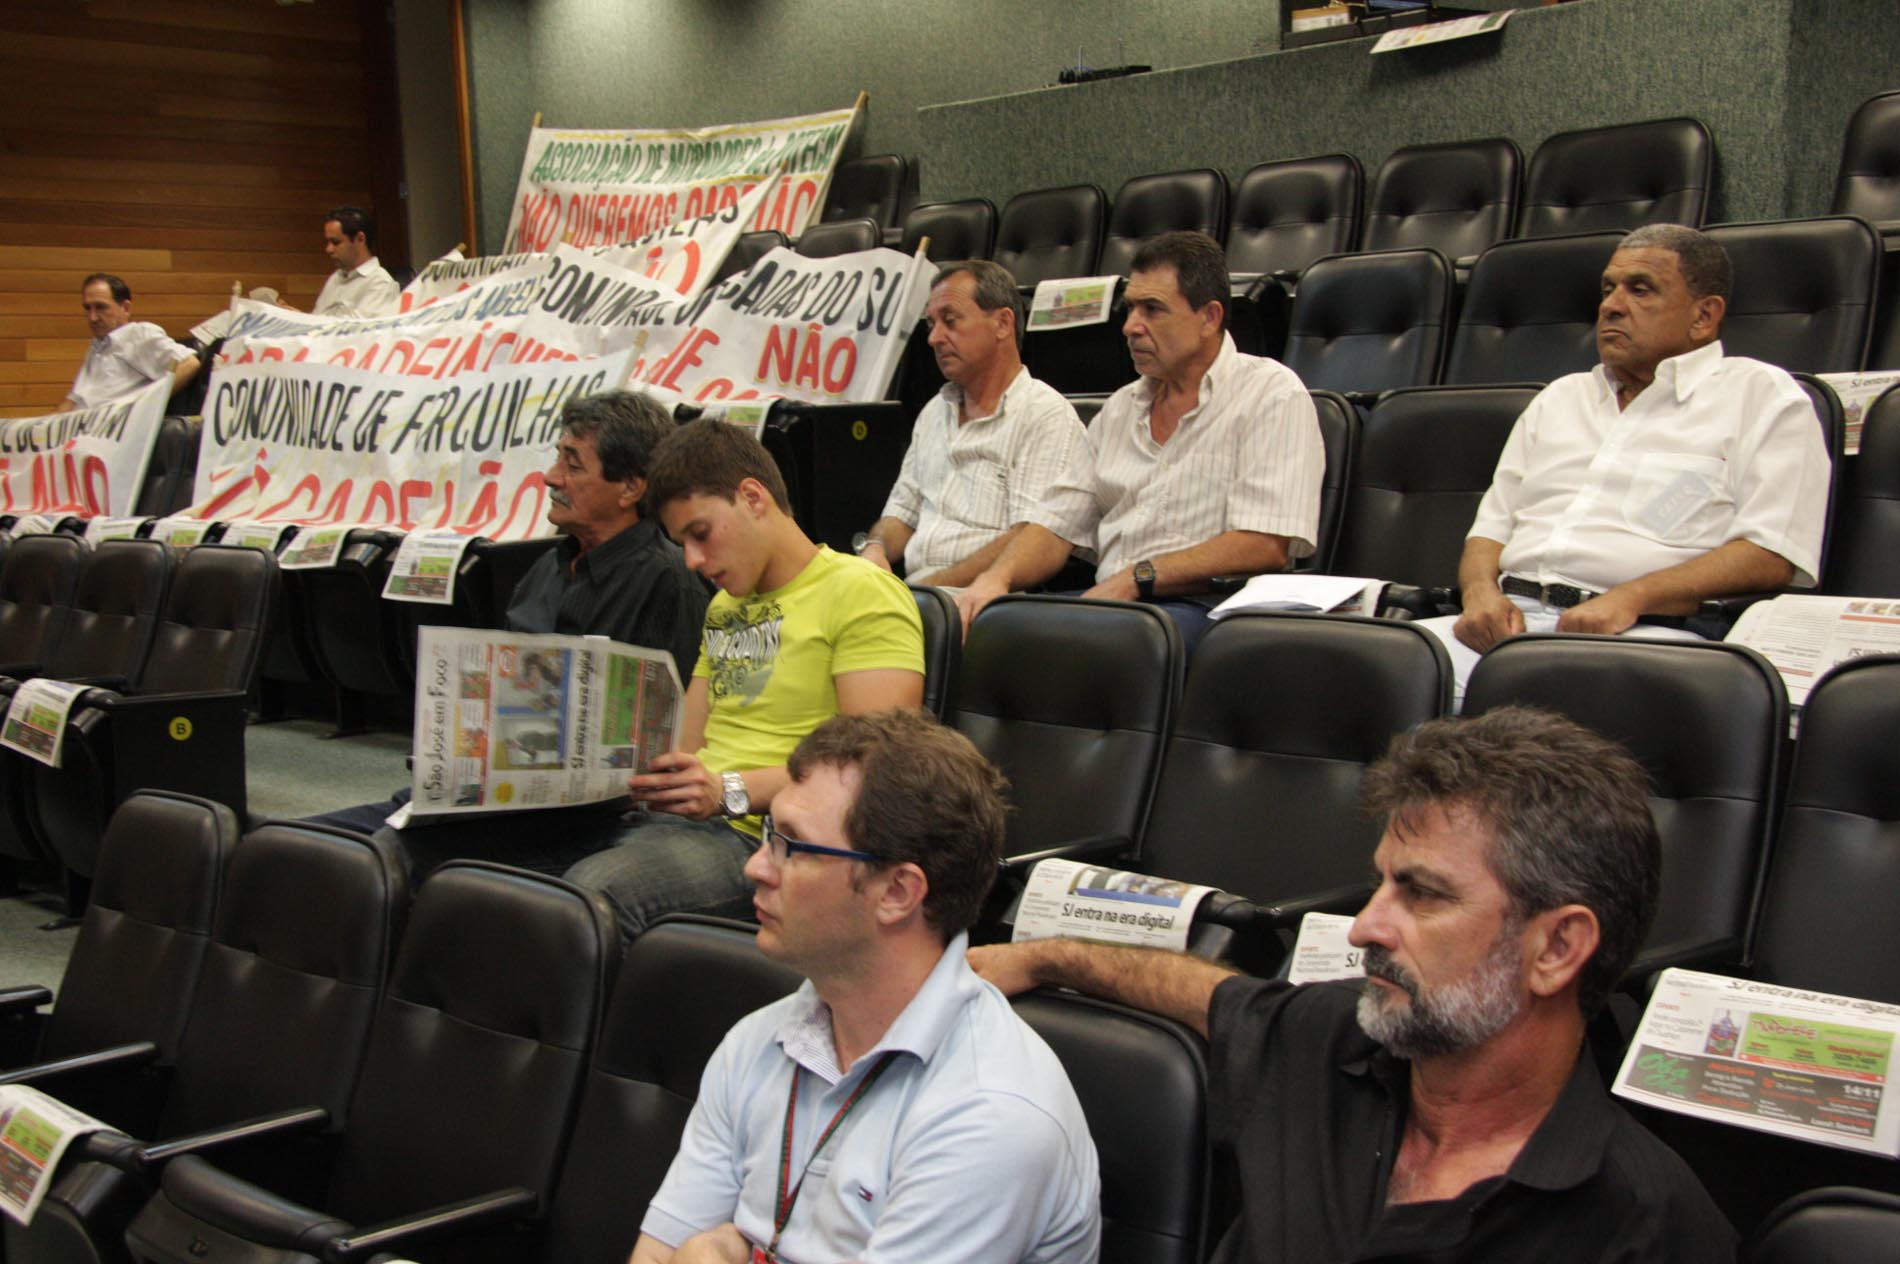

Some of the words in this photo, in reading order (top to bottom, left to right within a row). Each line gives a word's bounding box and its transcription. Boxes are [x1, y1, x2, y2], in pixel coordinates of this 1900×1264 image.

[517, 187, 563, 254] NÃO
[755, 322, 858, 395] NÃO
[427, 659, 448, 698] Foco
[177, 723, 187, 735] B
[1062, 903, 1075, 917] SJ
[1074, 907, 1103, 921] entra
[1104, 909, 1119, 923] na
[1119, 912, 1136, 925] era
[1137, 912, 1176, 932] digital
[1345, 952, 1360, 968] SJ
[1748, 982, 1793, 998] entra
[1820, 995, 1849, 1007] era
